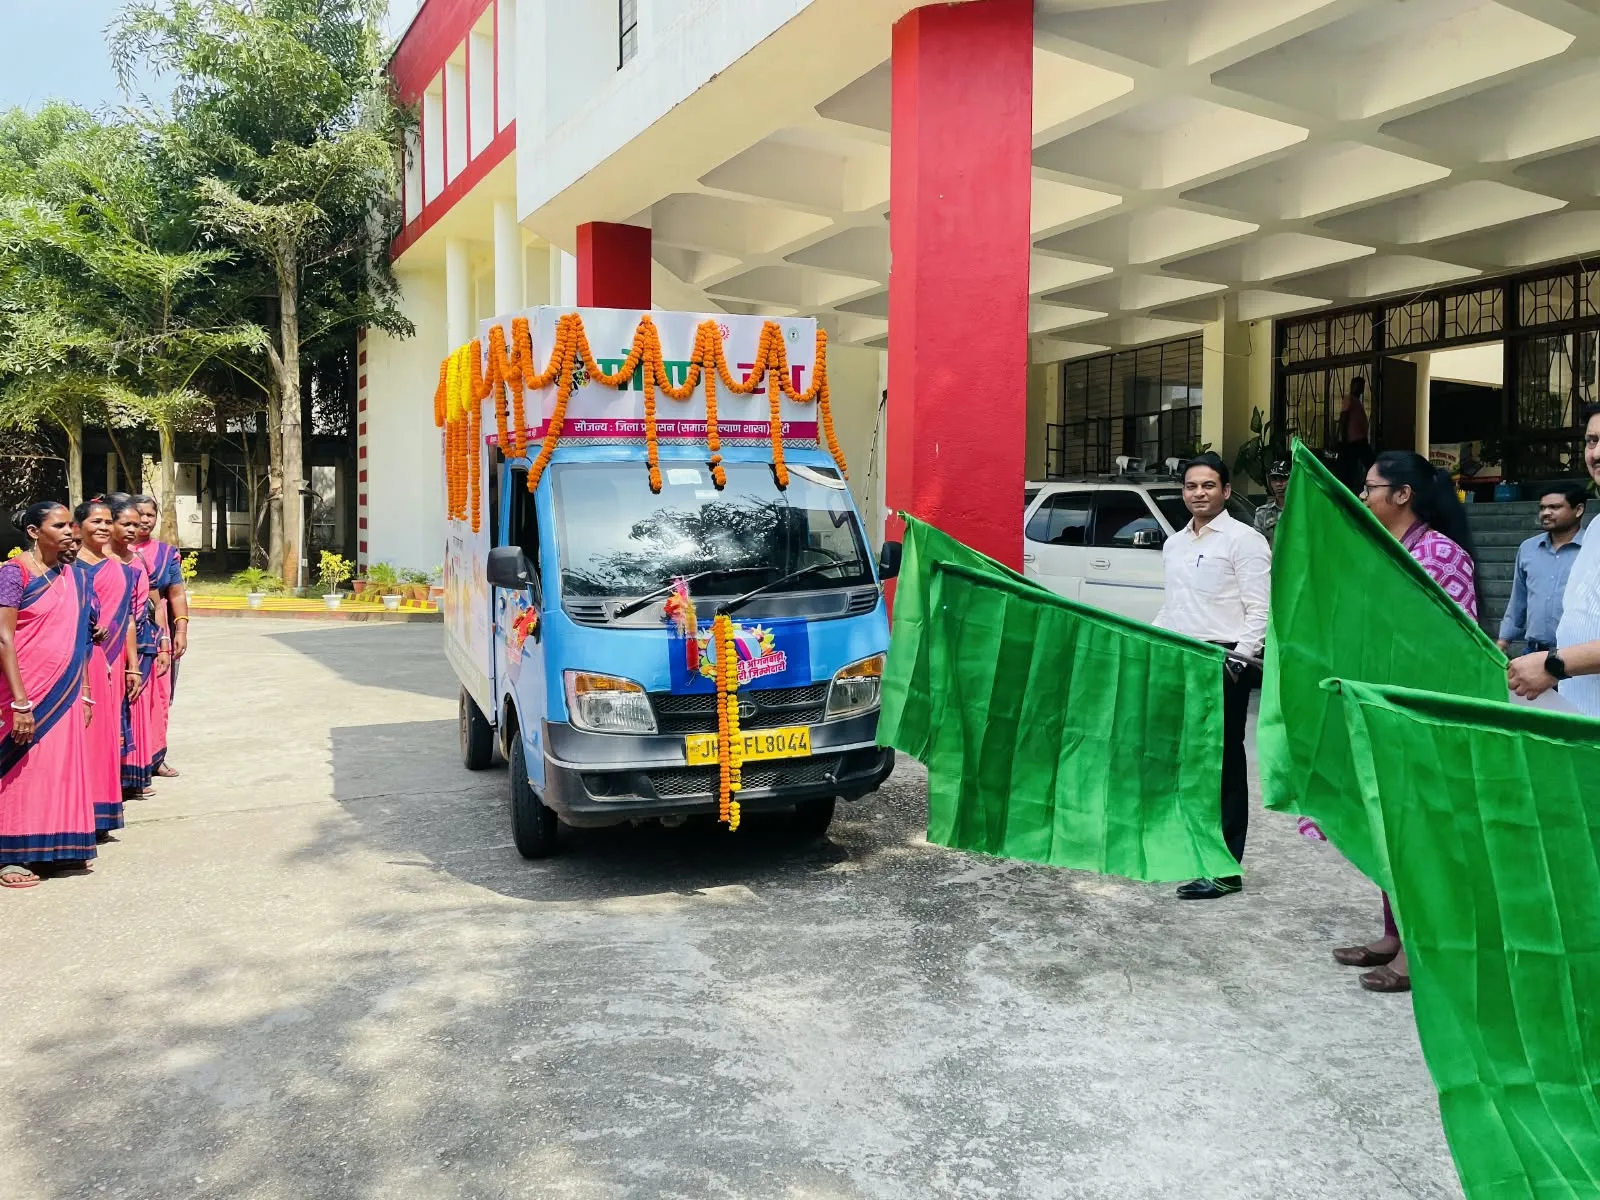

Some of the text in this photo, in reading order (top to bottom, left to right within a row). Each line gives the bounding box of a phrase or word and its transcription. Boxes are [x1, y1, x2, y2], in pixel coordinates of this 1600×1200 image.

[574, 420, 608, 432] सौजन्य
[615, 420, 639, 432] जिला
[717, 423, 741, 433] ल्याण
[702, 732, 807, 758] JHFL8044
